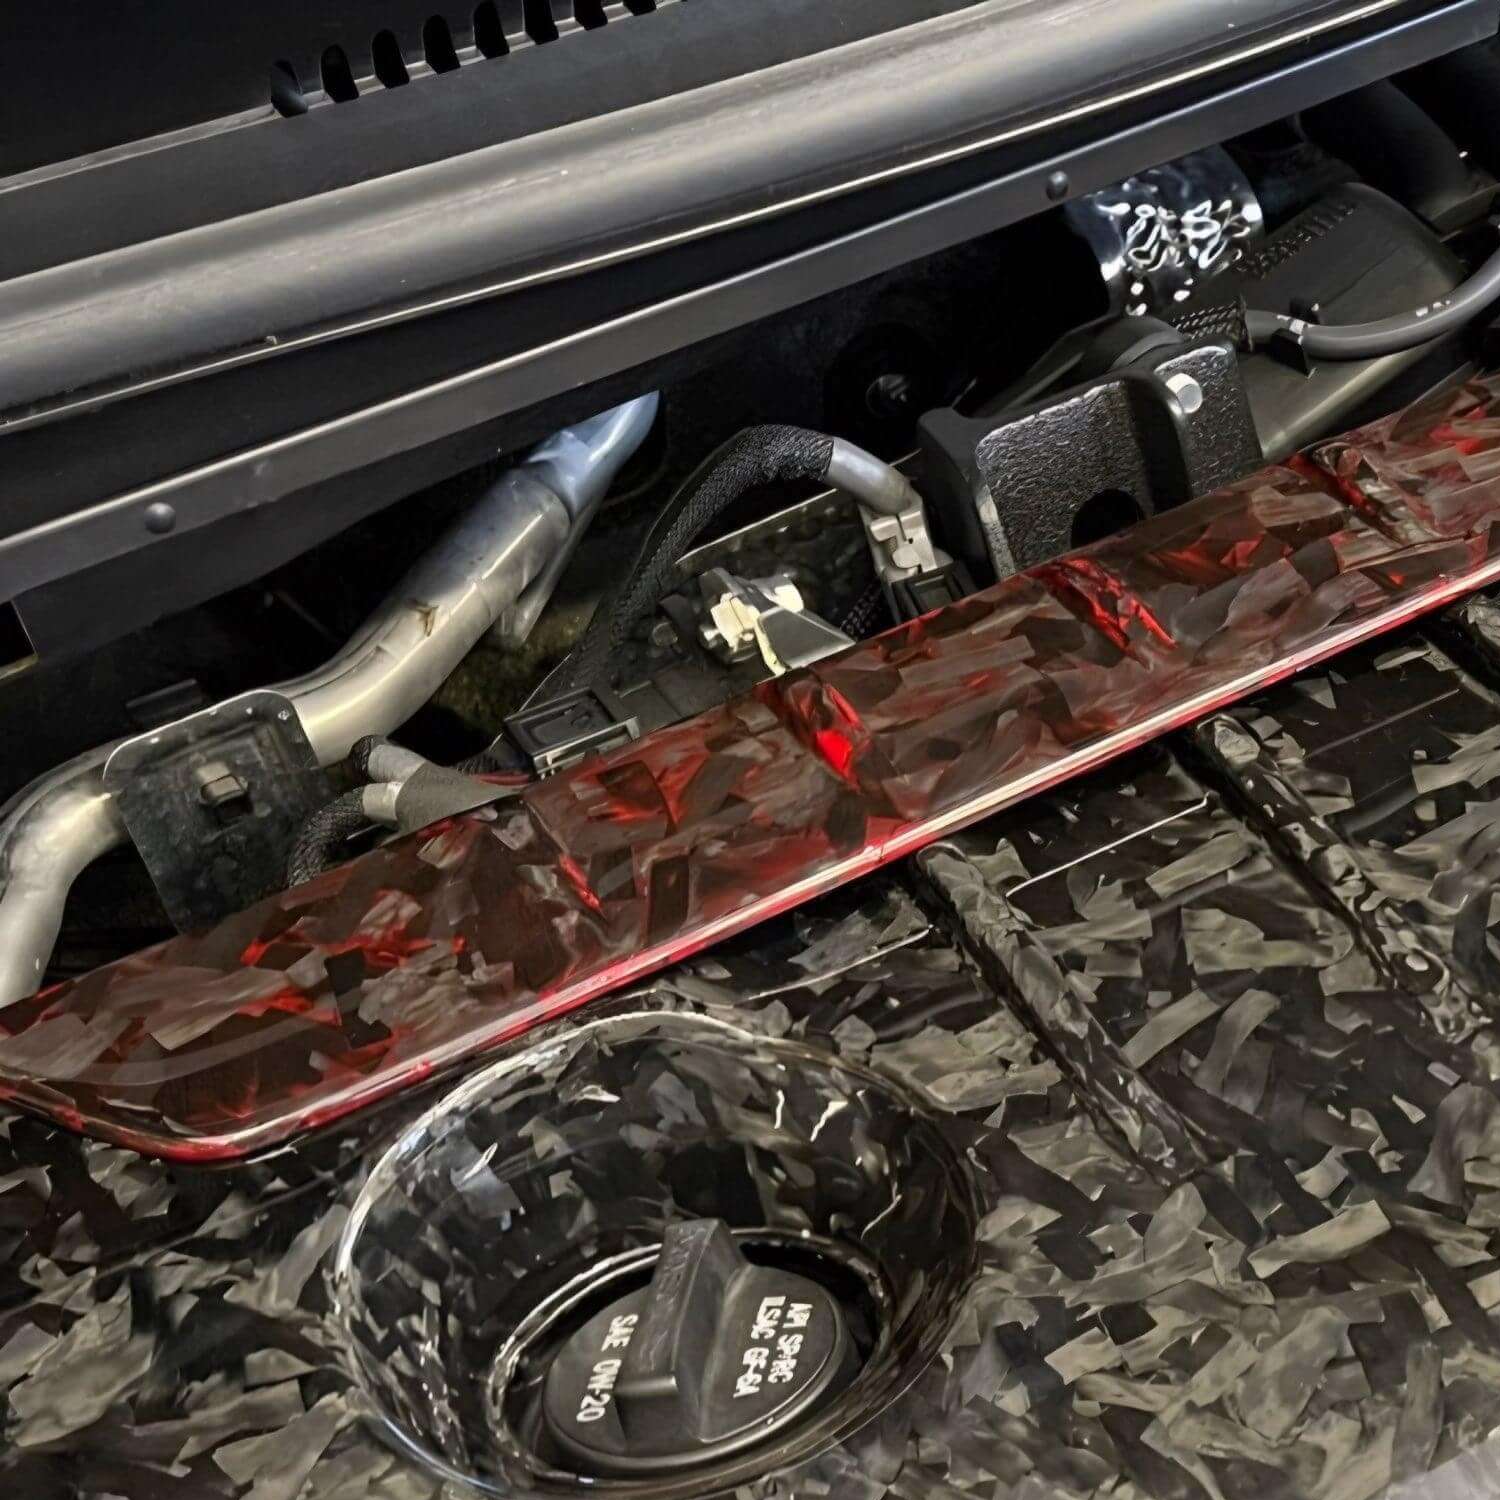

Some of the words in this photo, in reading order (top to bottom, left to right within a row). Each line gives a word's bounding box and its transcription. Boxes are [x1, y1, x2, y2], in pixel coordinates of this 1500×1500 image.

[601, 1314, 639, 1352] SAE
[783, 1303, 813, 1328] API
[576, 1359, 622, 1422] 0W-20
